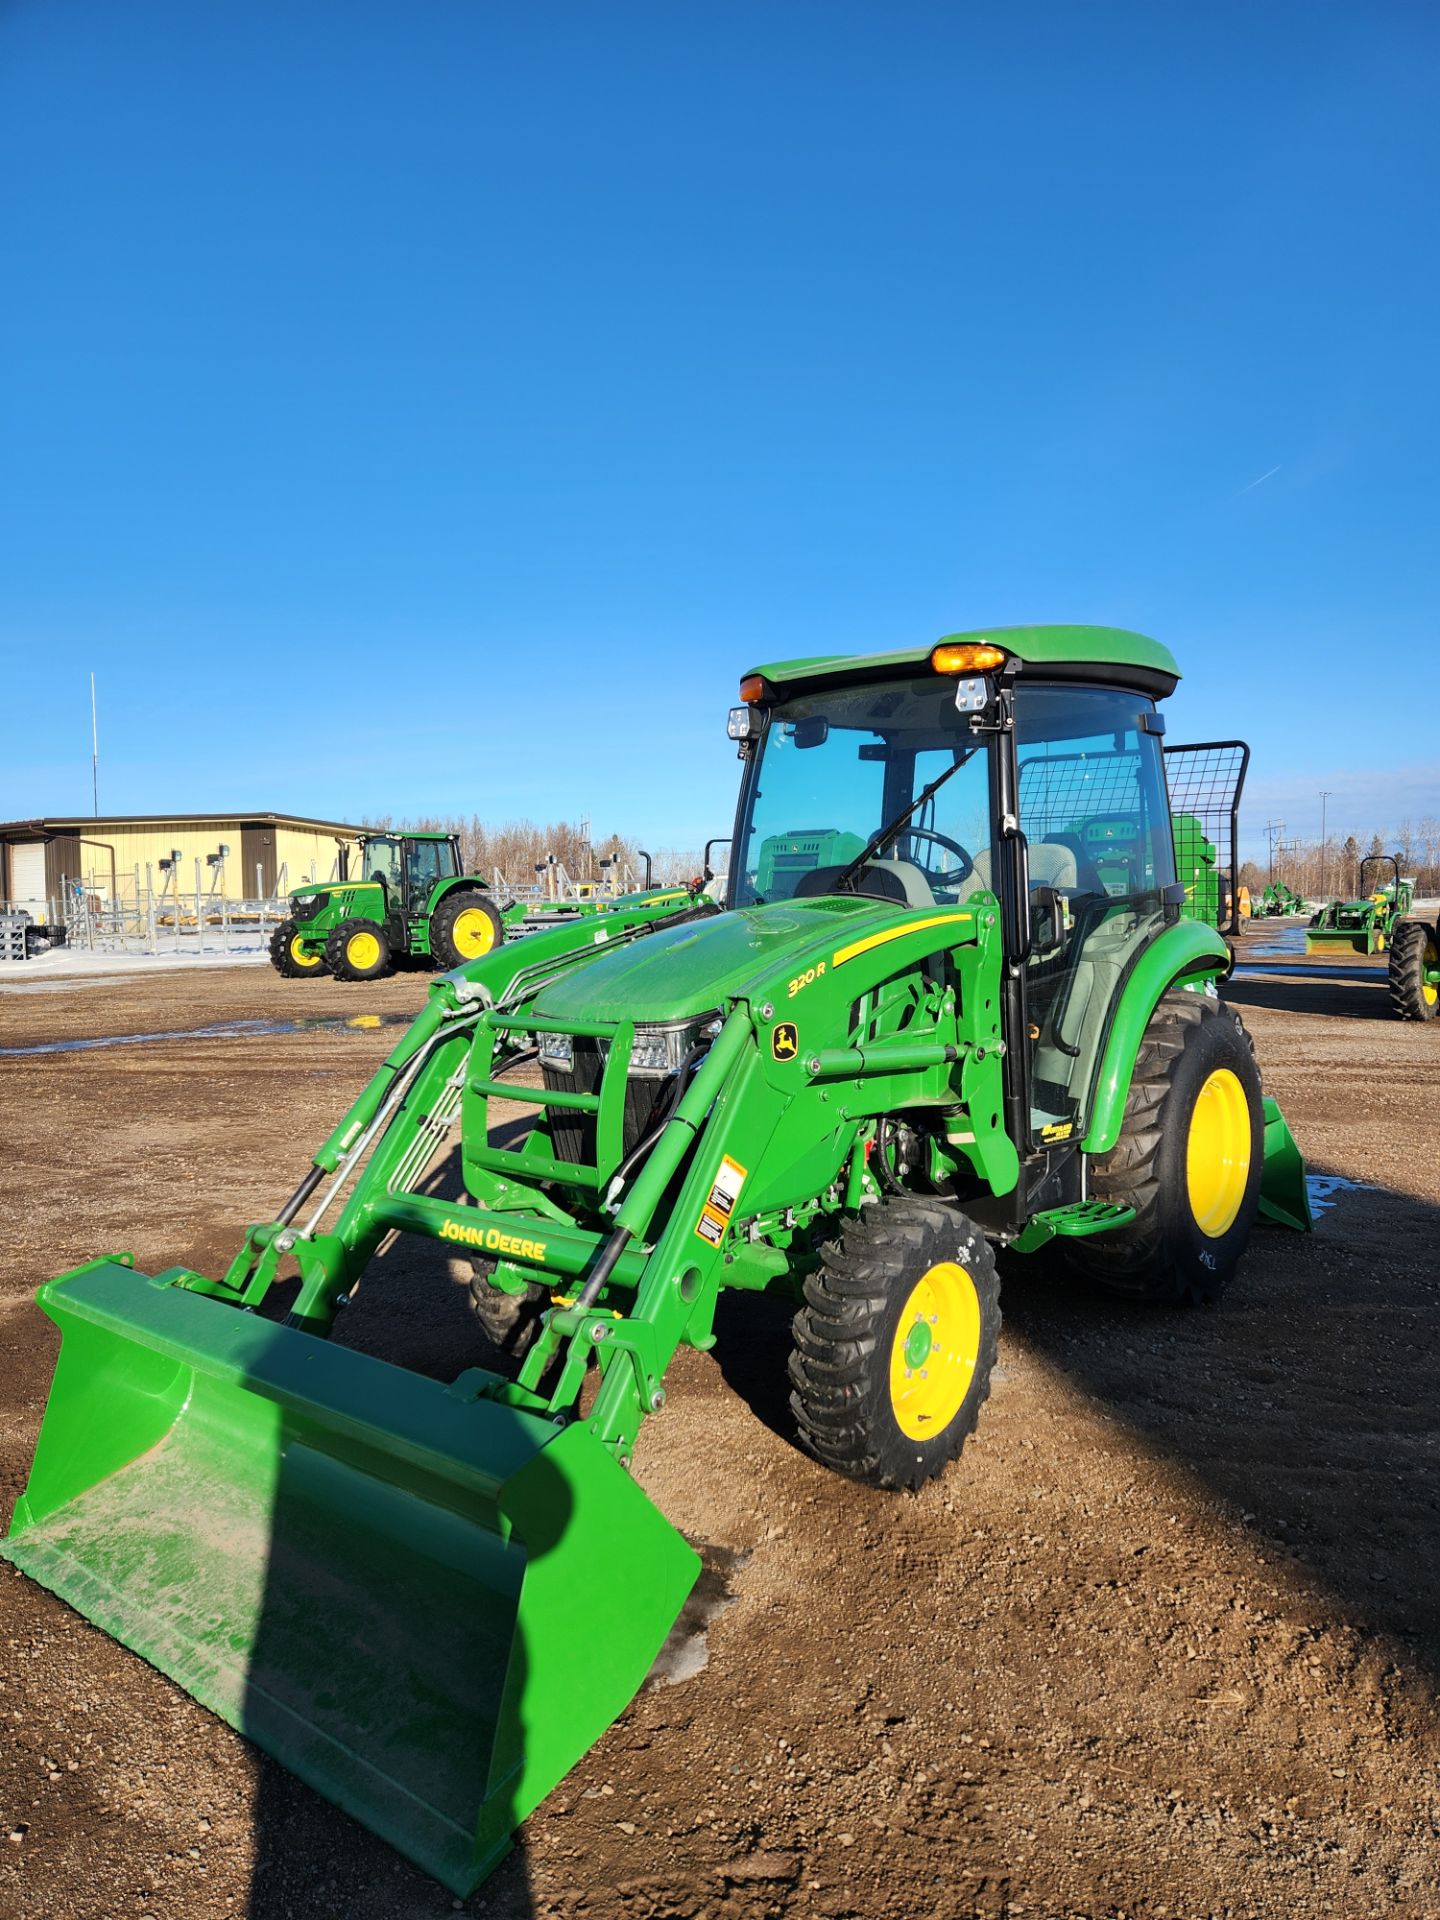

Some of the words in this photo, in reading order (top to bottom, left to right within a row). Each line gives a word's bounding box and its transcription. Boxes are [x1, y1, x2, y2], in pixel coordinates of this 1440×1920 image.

[788, 968, 815, 999] 320
[438, 1218, 484, 1247] JOHN
[485, 1228, 547, 1262] DEERE
